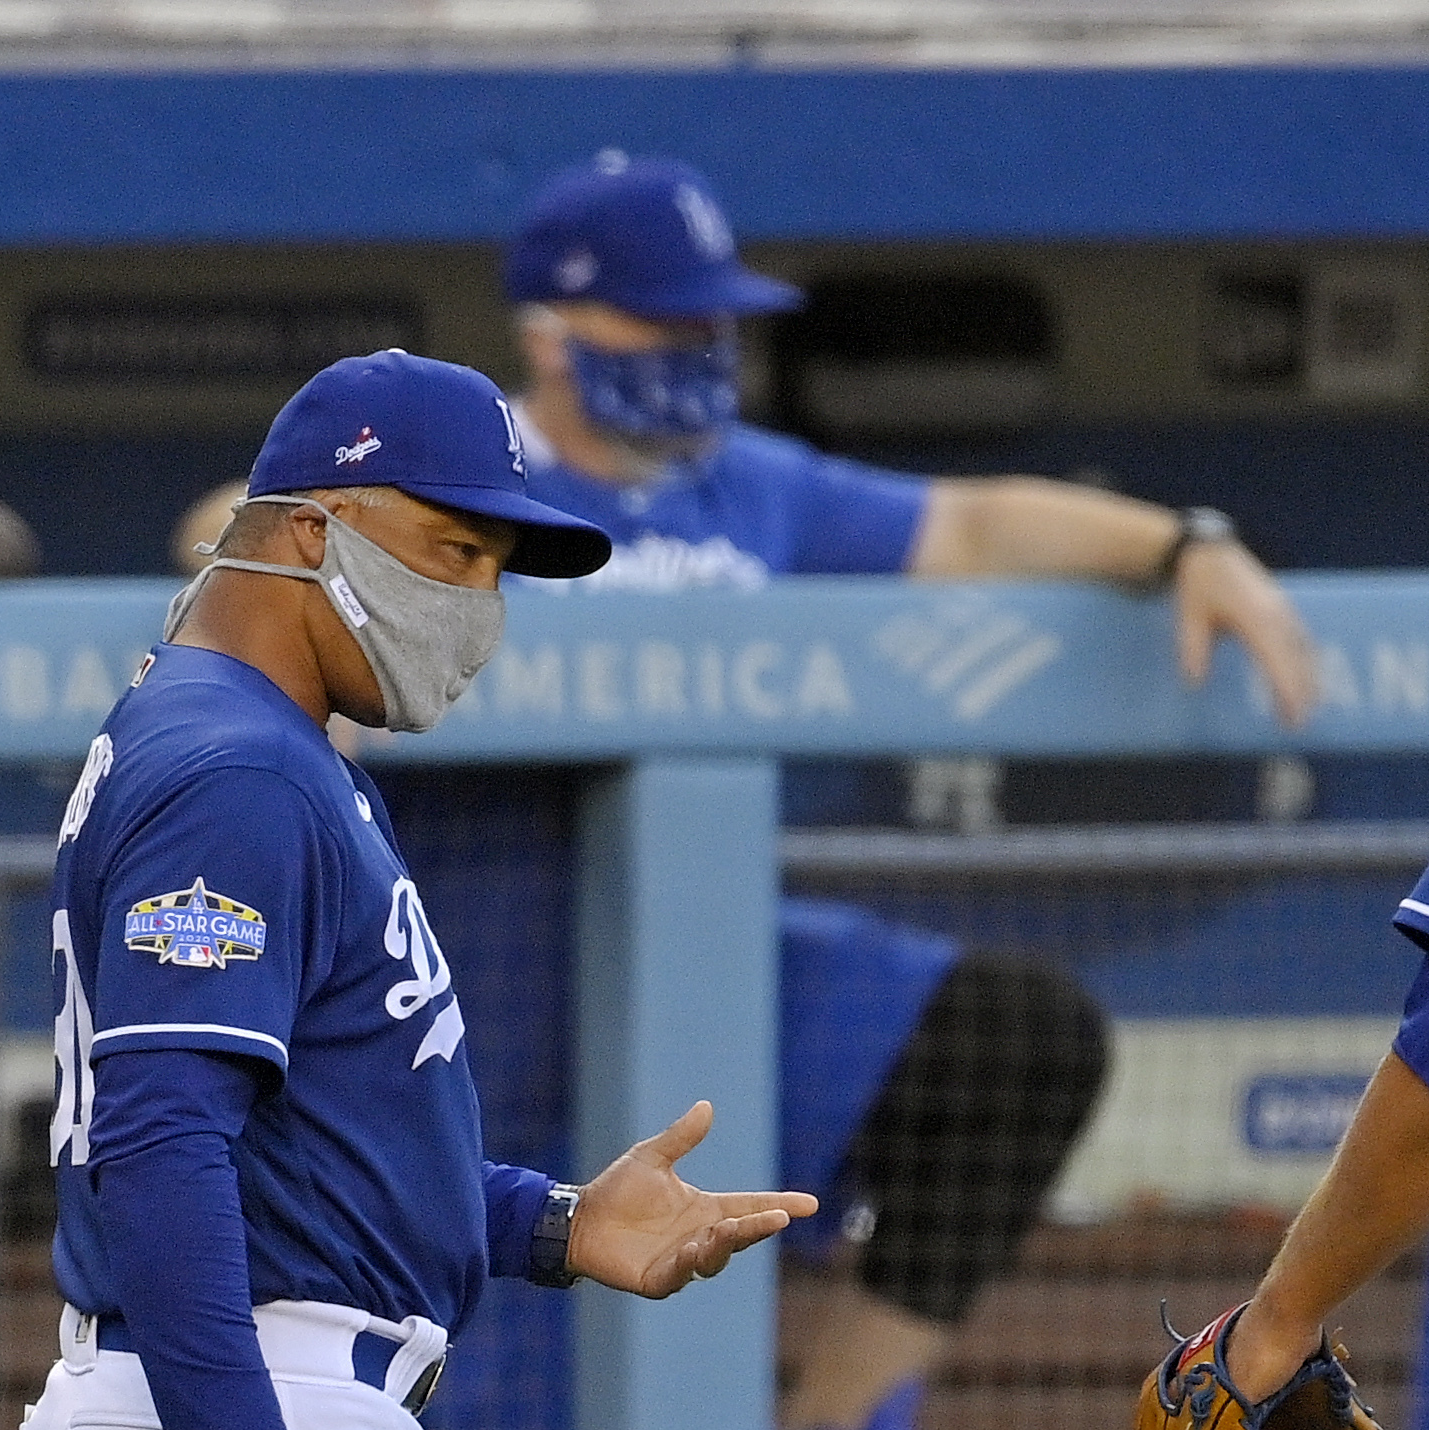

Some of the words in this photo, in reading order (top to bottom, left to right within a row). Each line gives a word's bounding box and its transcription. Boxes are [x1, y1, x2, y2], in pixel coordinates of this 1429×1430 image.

[334, 436, 382, 466] Dodgers
[454, 640, 854, 720] MERICA
[128, 916, 157, 933] ALL
[163, 913, 207, 933] STAR
[211, 917, 263, 945] GAME
[179, 935, 210, 943] 2020
